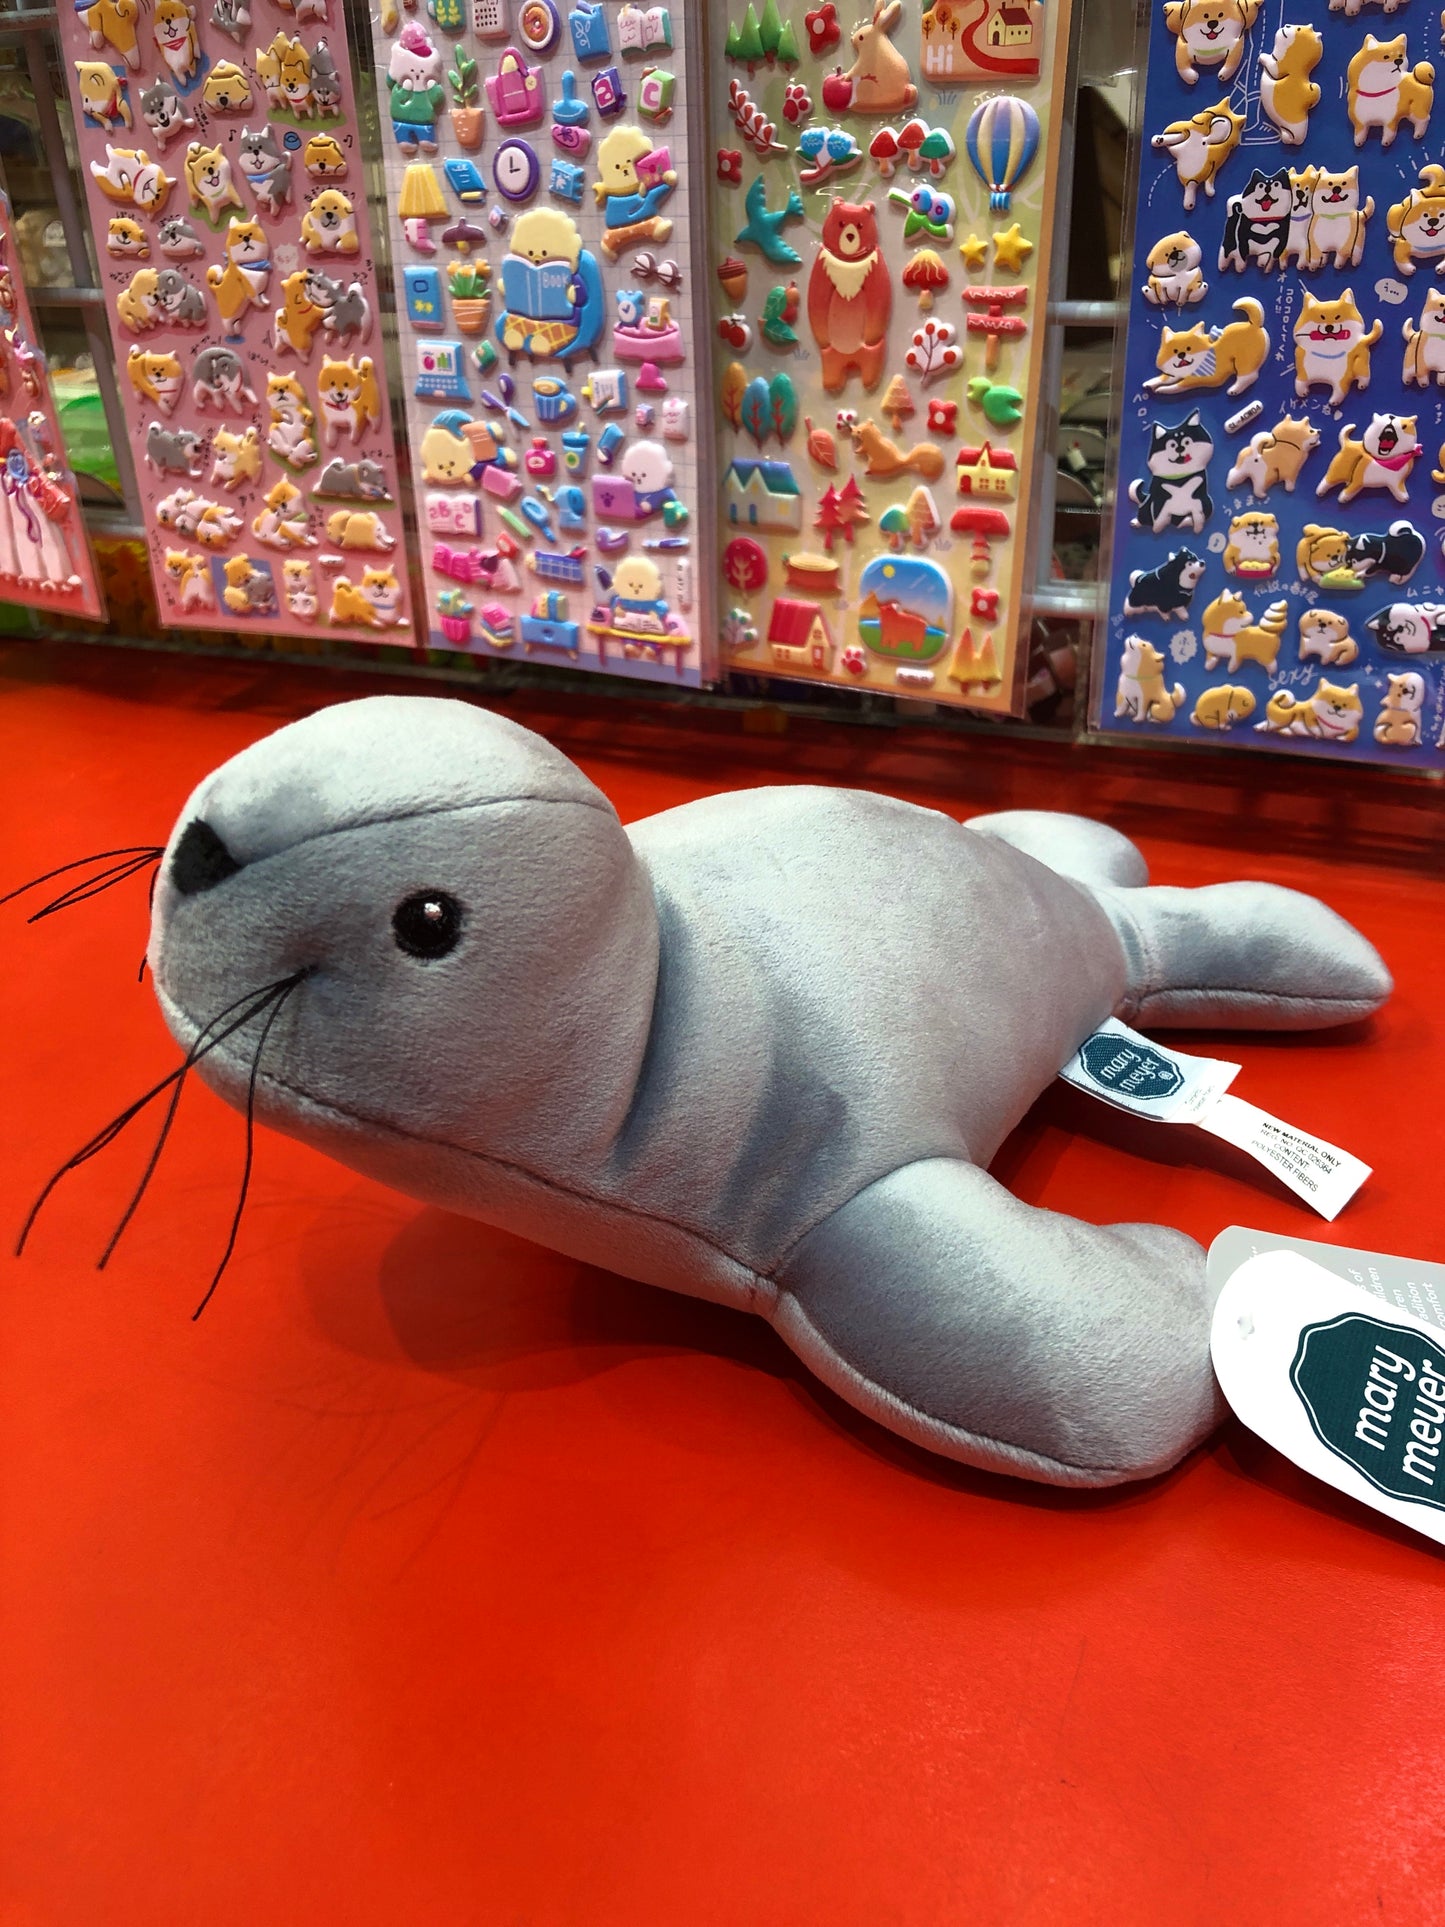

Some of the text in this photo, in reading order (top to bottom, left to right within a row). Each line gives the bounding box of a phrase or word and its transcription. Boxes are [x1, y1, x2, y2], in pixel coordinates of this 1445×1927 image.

[927, 44, 953, 74] Hi
[1100, 1048, 1142, 1080] mary
[1119, 1056, 1160, 1092] meyer
[1251, 1139, 1319, 1192] POLYESTER FIBERS
[1262, 1122, 1342, 1168] NEW MATERIAL ONLY
[1406, 1281, 1429, 1321] adition
[1355, 1344, 1416, 1451] mary
[1402, 1358, 1445, 1486] meyer
